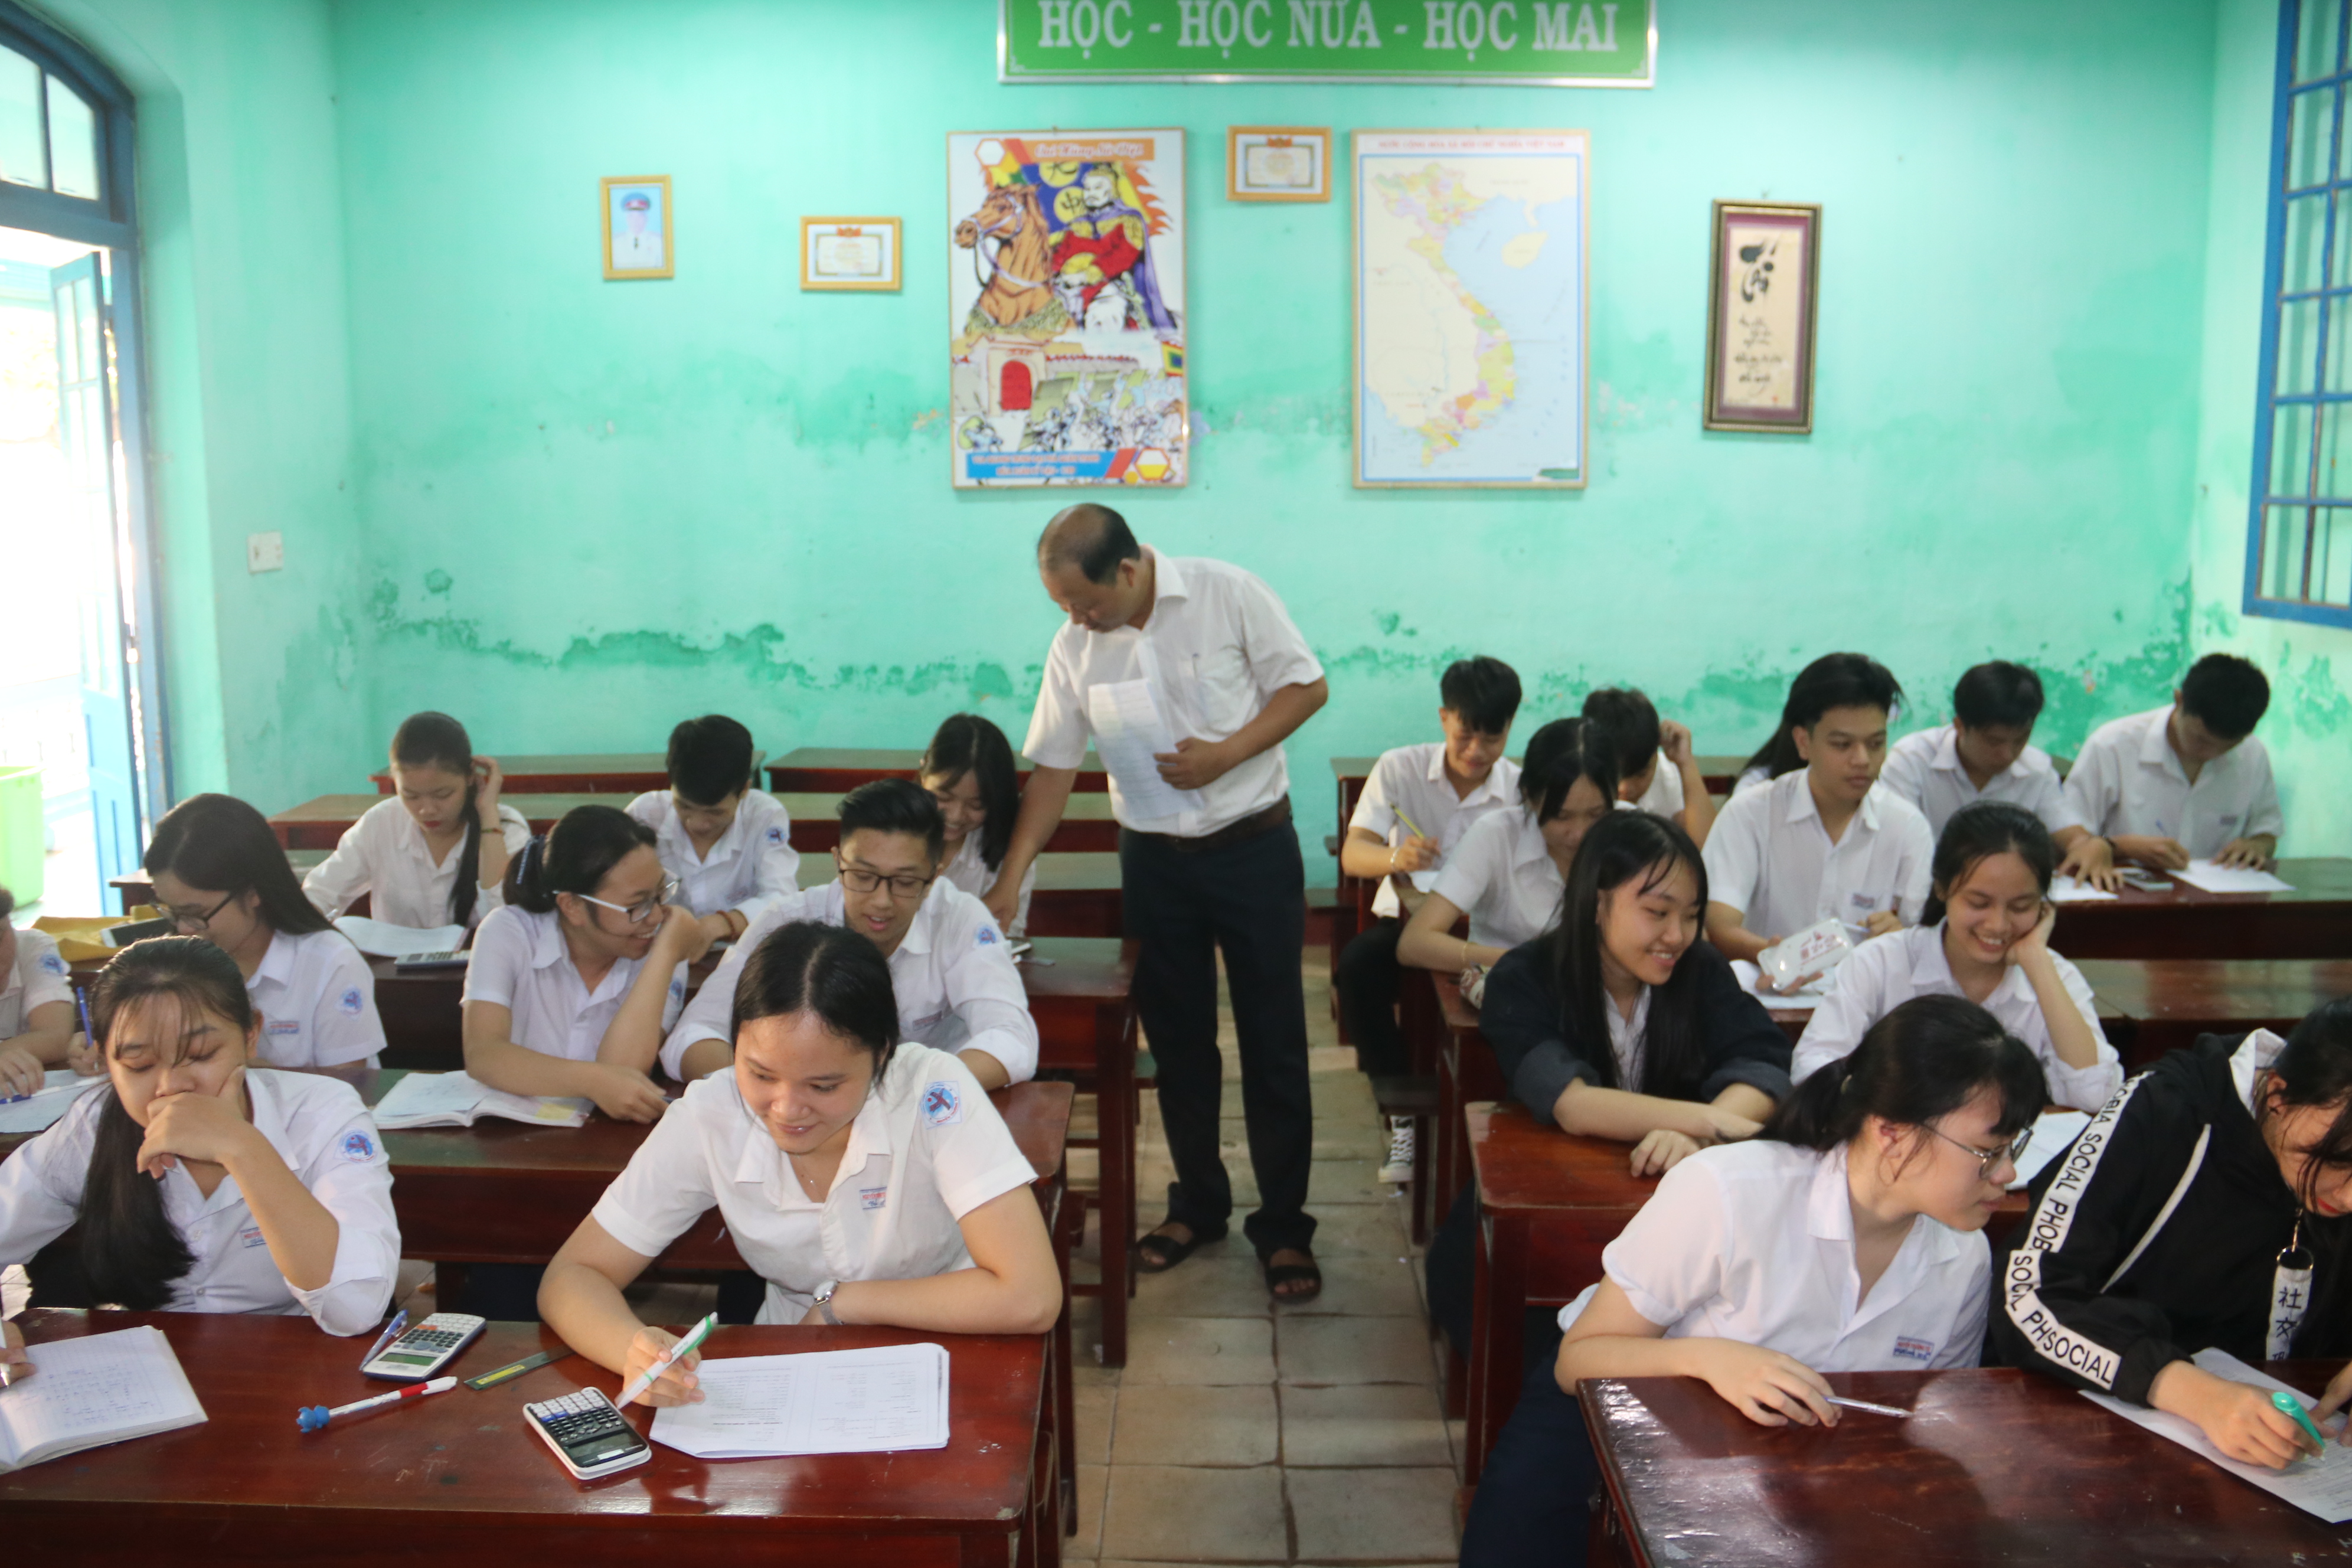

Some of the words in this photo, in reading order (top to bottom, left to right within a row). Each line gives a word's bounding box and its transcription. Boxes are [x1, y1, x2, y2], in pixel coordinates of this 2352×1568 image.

[1037, 0, 1132, 59] HỌC
[1177, 0, 1272, 59] HỌC
[1423, 0, 1518, 61] HỌC
[2094, 1080, 2132, 1123] OBIA
[2055, 1132, 2102, 1190] SOCIAL
[2031, 1197, 2069, 1250] PHOB
